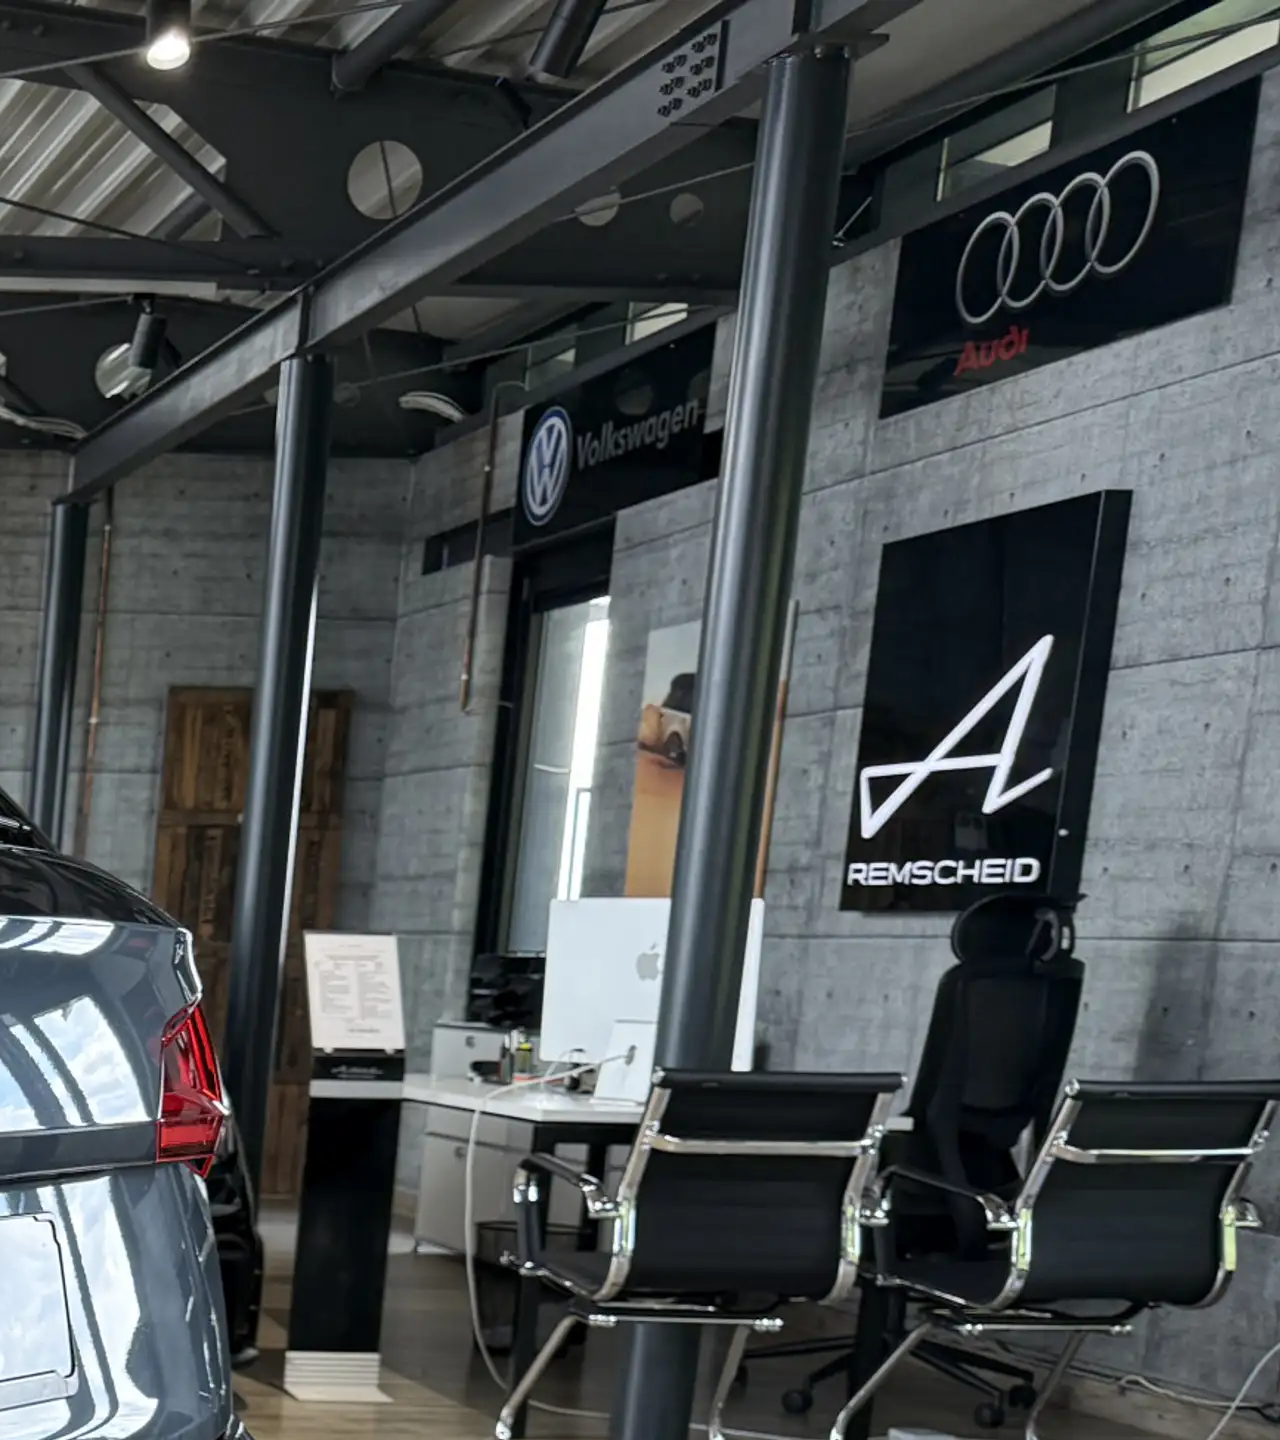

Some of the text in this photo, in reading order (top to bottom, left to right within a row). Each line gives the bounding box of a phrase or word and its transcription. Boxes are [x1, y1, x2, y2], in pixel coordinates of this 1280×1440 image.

[953, 324, 1029, 376] Audi
[577, 398, 699, 471] Volkswagen
[847, 856, 1041, 886] REMSCHEID
